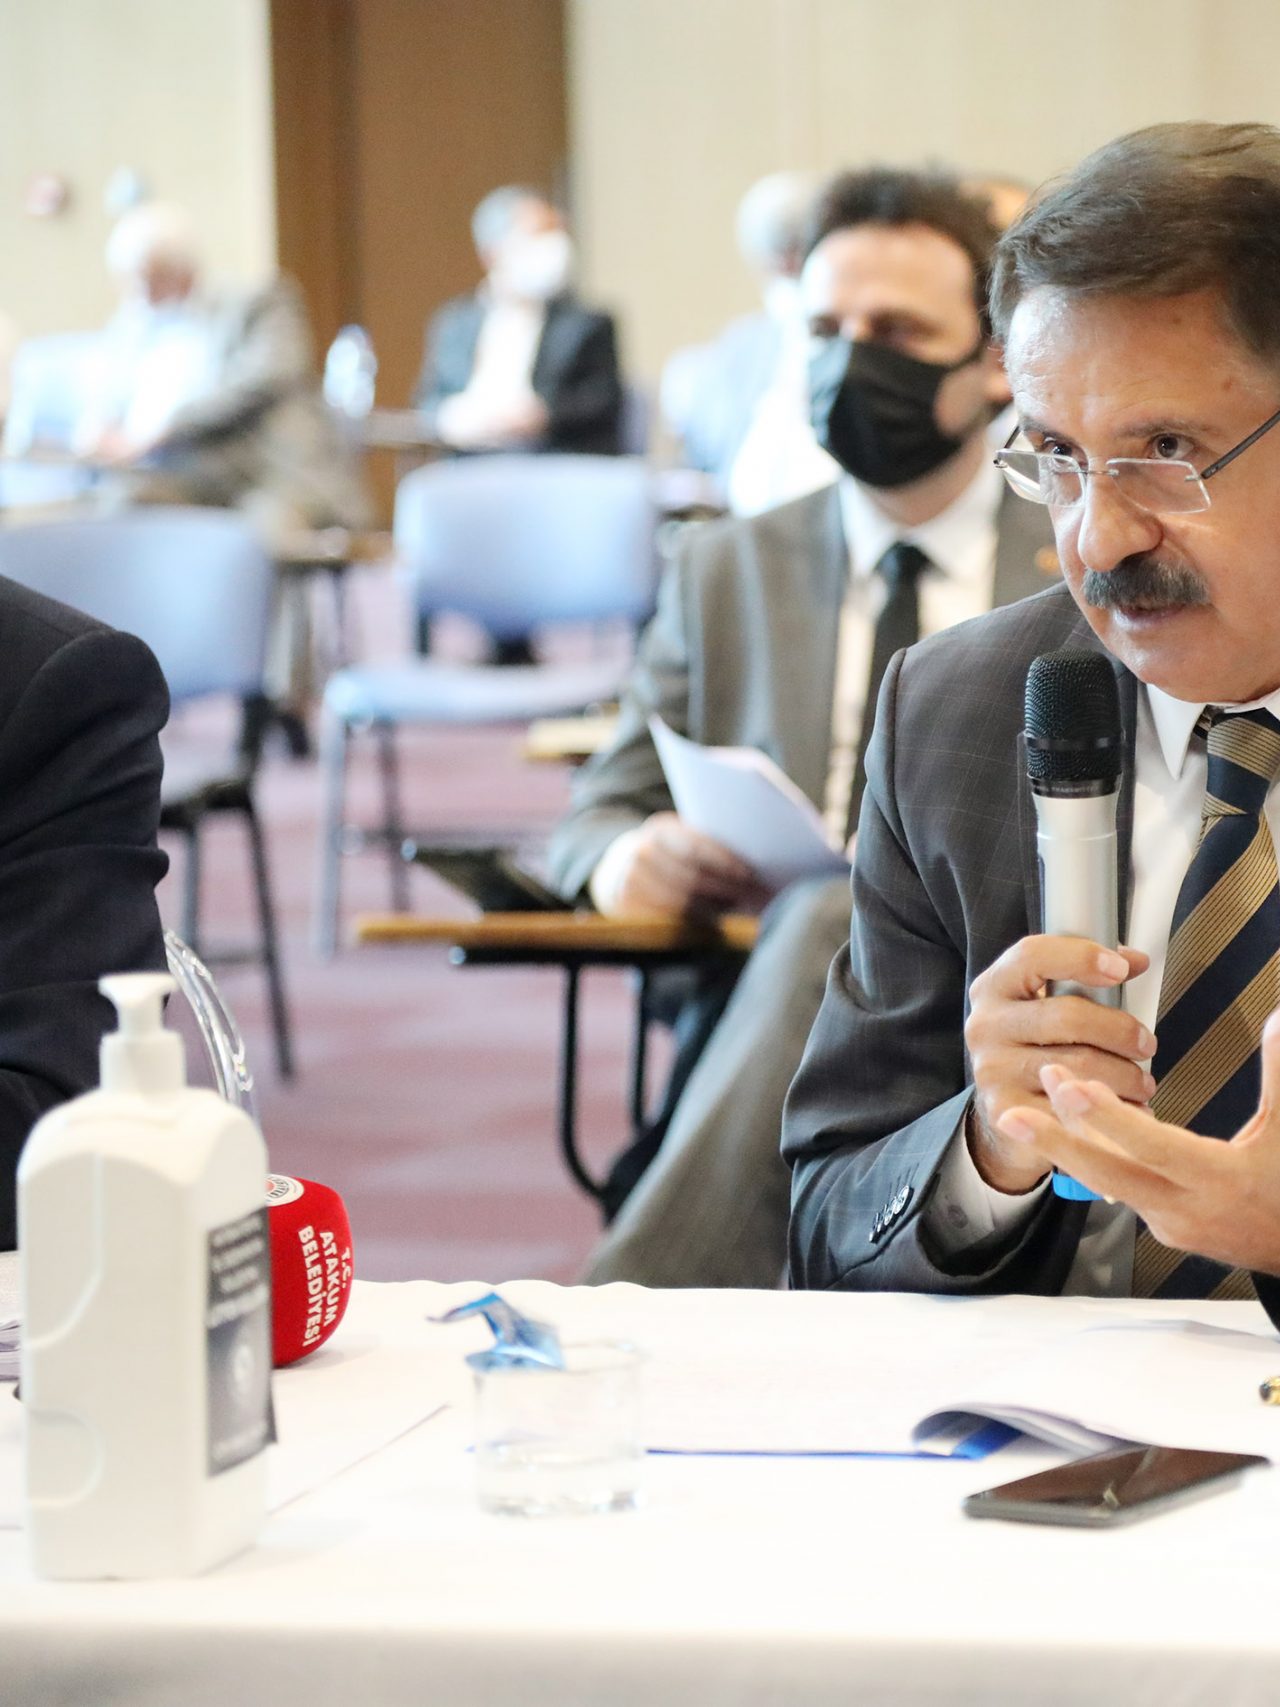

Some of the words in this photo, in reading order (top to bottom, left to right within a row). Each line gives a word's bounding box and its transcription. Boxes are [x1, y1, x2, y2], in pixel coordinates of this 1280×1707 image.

[298, 1225, 328, 1347] BELEDİYESİ
[319, 1231, 340, 1327] ATAKUM
[340, 1246, 352, 1289] T.C.
